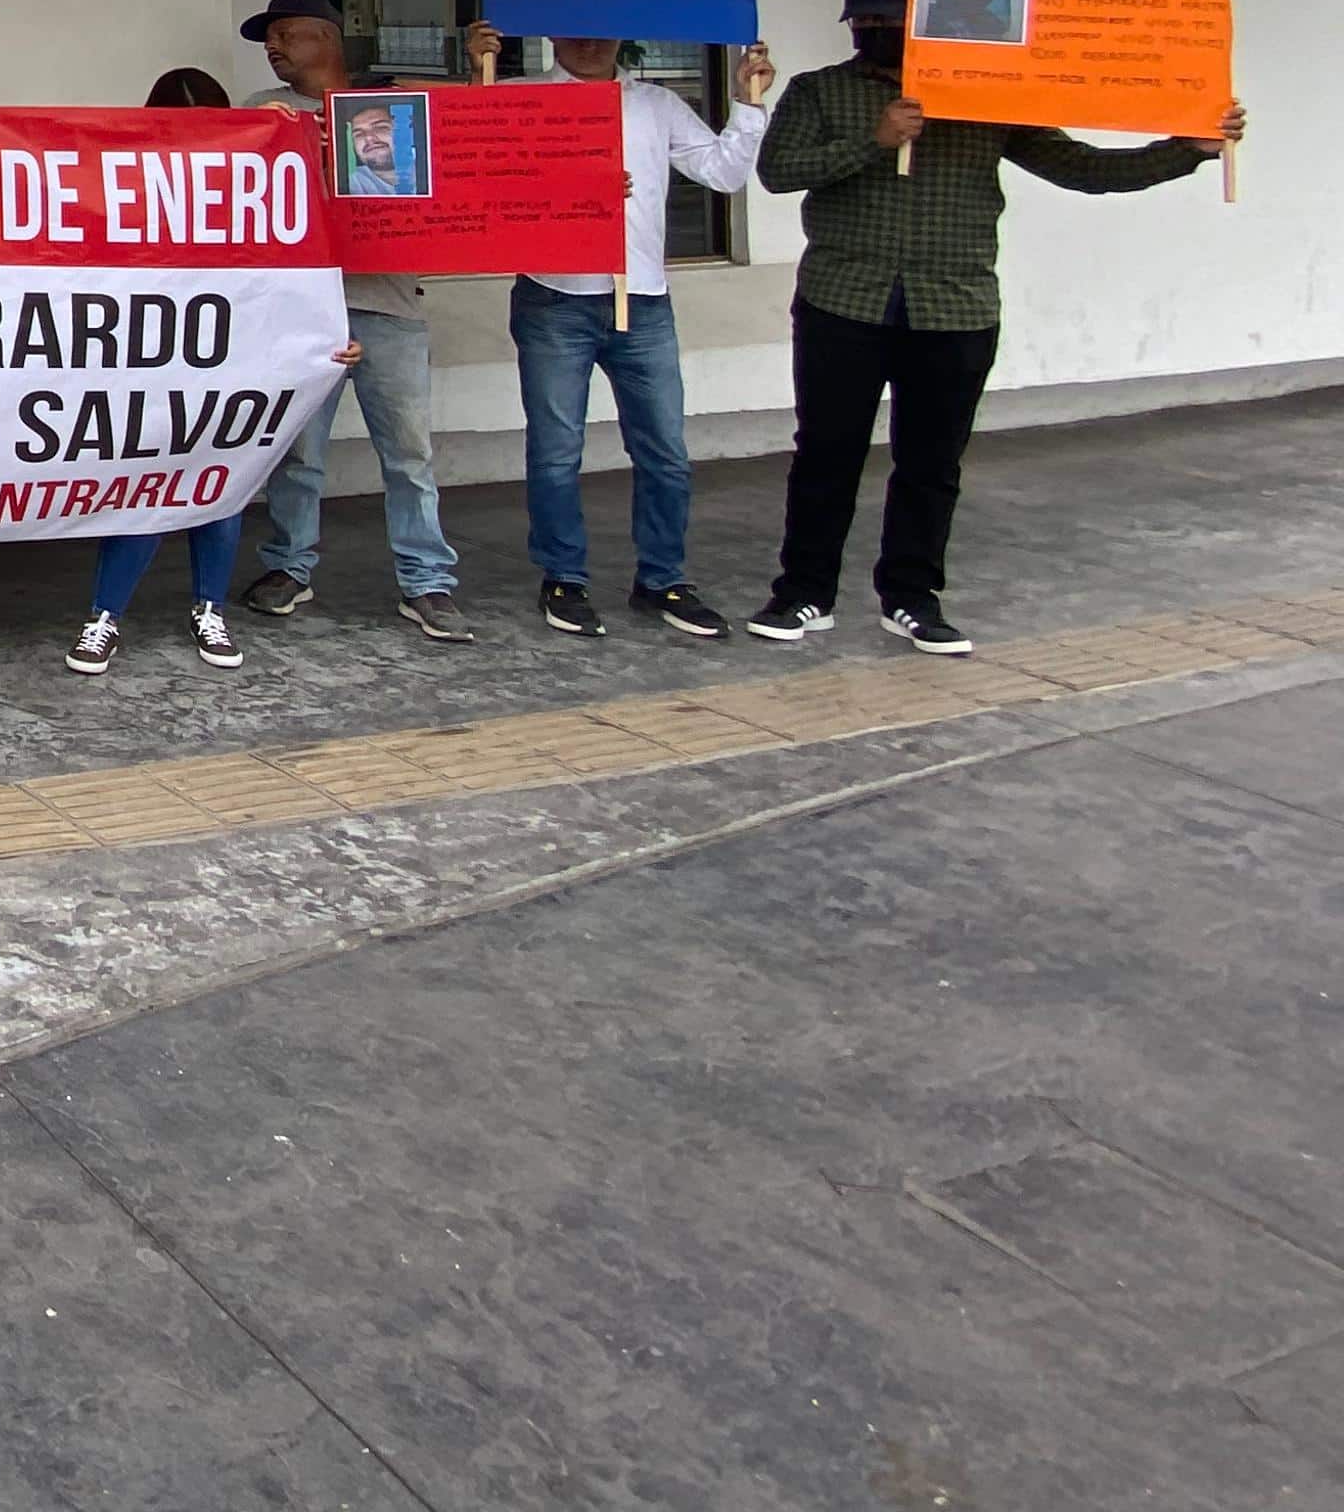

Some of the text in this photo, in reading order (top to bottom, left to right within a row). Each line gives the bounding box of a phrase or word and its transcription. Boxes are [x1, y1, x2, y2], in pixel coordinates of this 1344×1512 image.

[917, 67, 943, 80] NO
[0, 147, 86, 244] DE
[102, 150, 309, 245] ENERO
[16, 388, 295, 465] SALVO!
